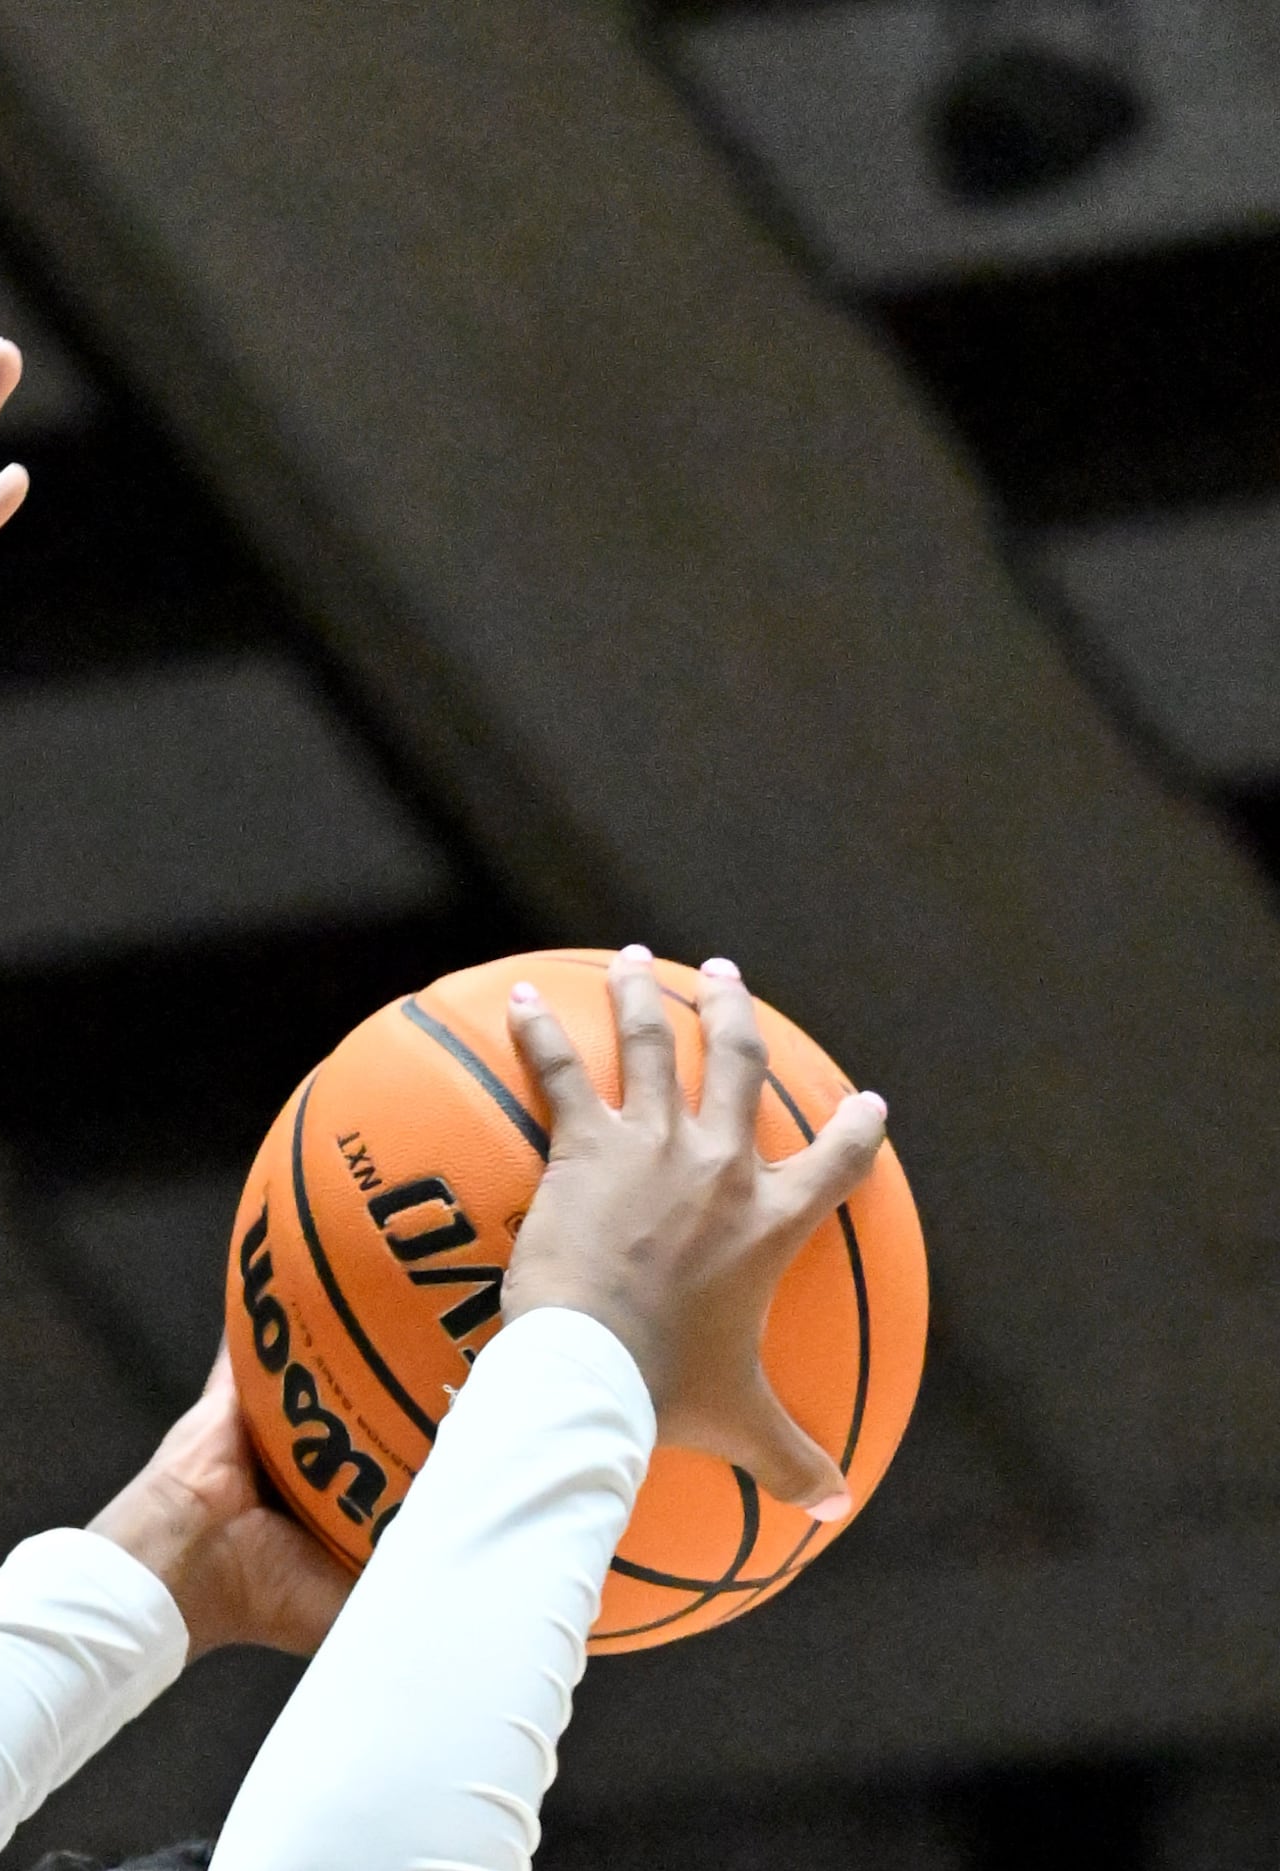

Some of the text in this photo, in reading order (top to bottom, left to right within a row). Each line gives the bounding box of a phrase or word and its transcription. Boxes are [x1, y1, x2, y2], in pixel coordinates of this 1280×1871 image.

[239, 1183, 402, 1548] ilson
[336, 1130, 506, 1369] VO NXT
